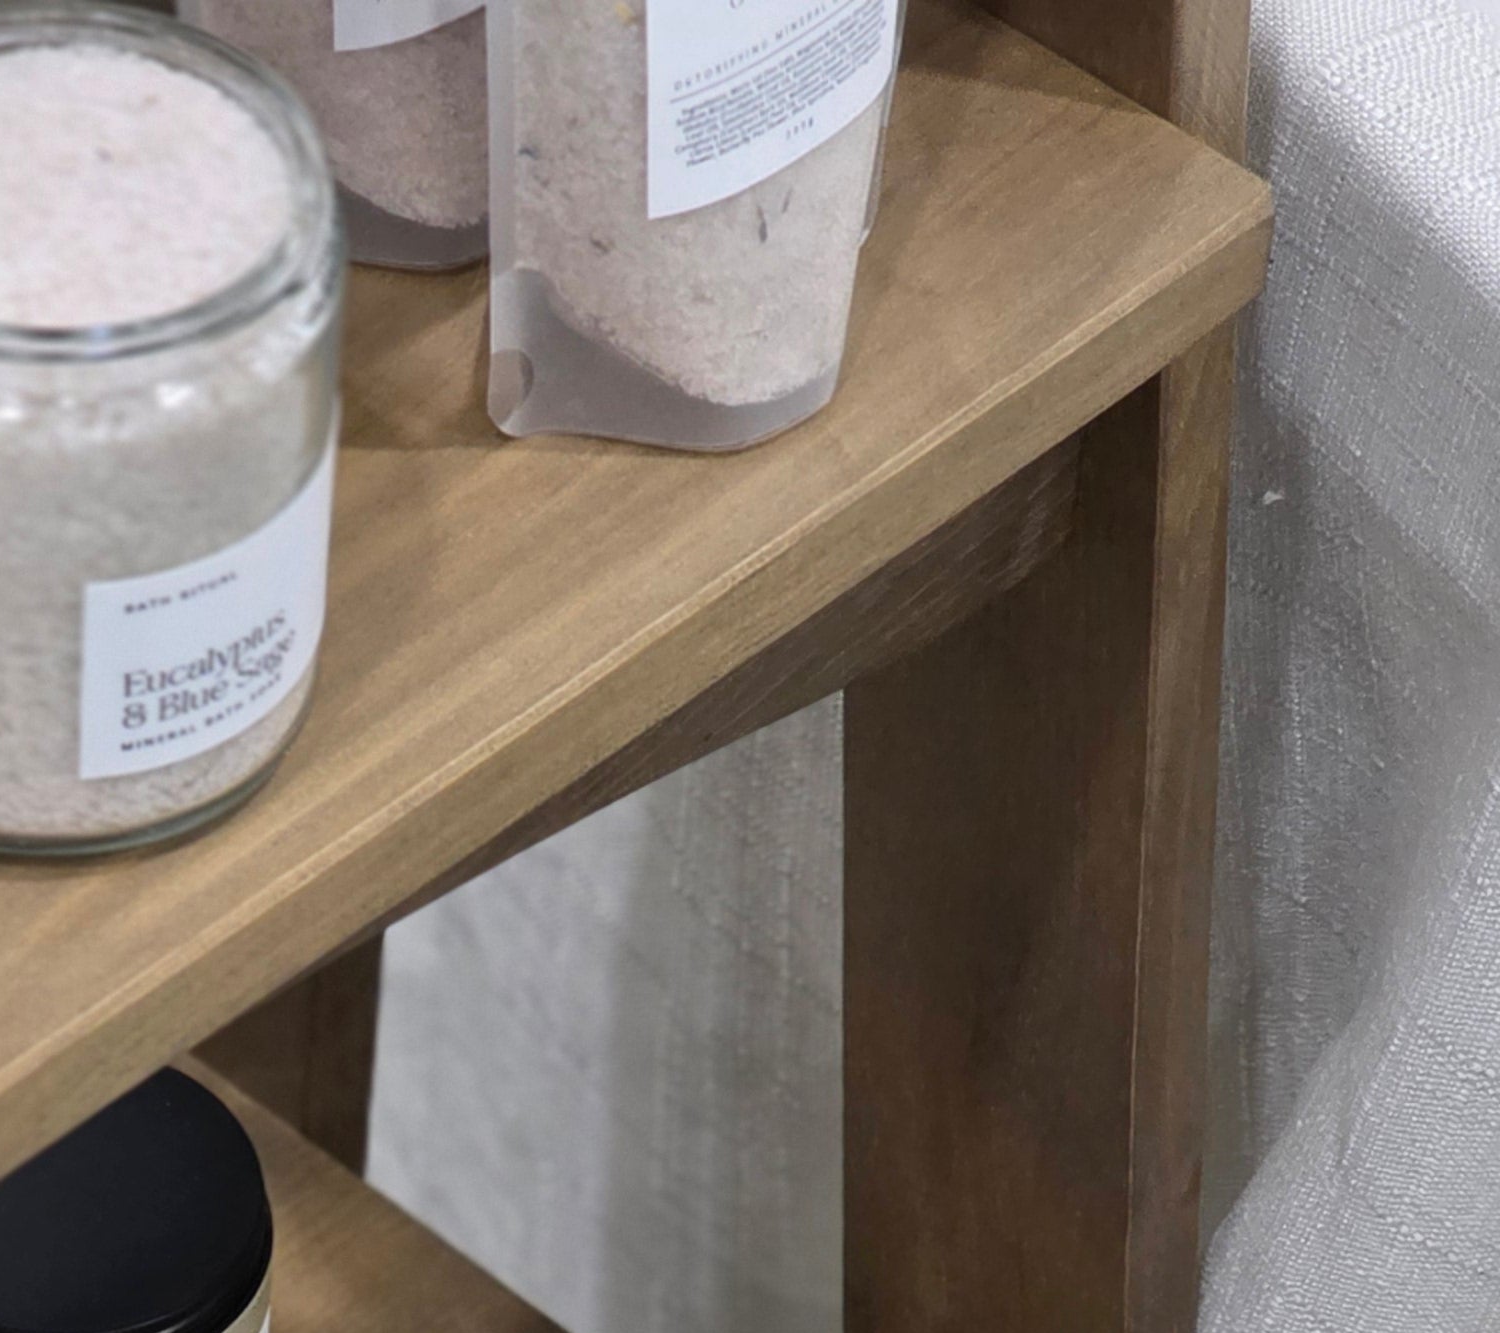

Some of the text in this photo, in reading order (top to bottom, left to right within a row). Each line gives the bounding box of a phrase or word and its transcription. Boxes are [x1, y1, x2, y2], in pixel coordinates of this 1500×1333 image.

[124, 571, 238, 614] BATH RITUAL
[122, 629, 296, 729] & Blue Sage
[123, 609, 285, 699] Eucalyptus
[120, 726, 196, 751] MINERAL
[205, 702, 243, 726] BATH
